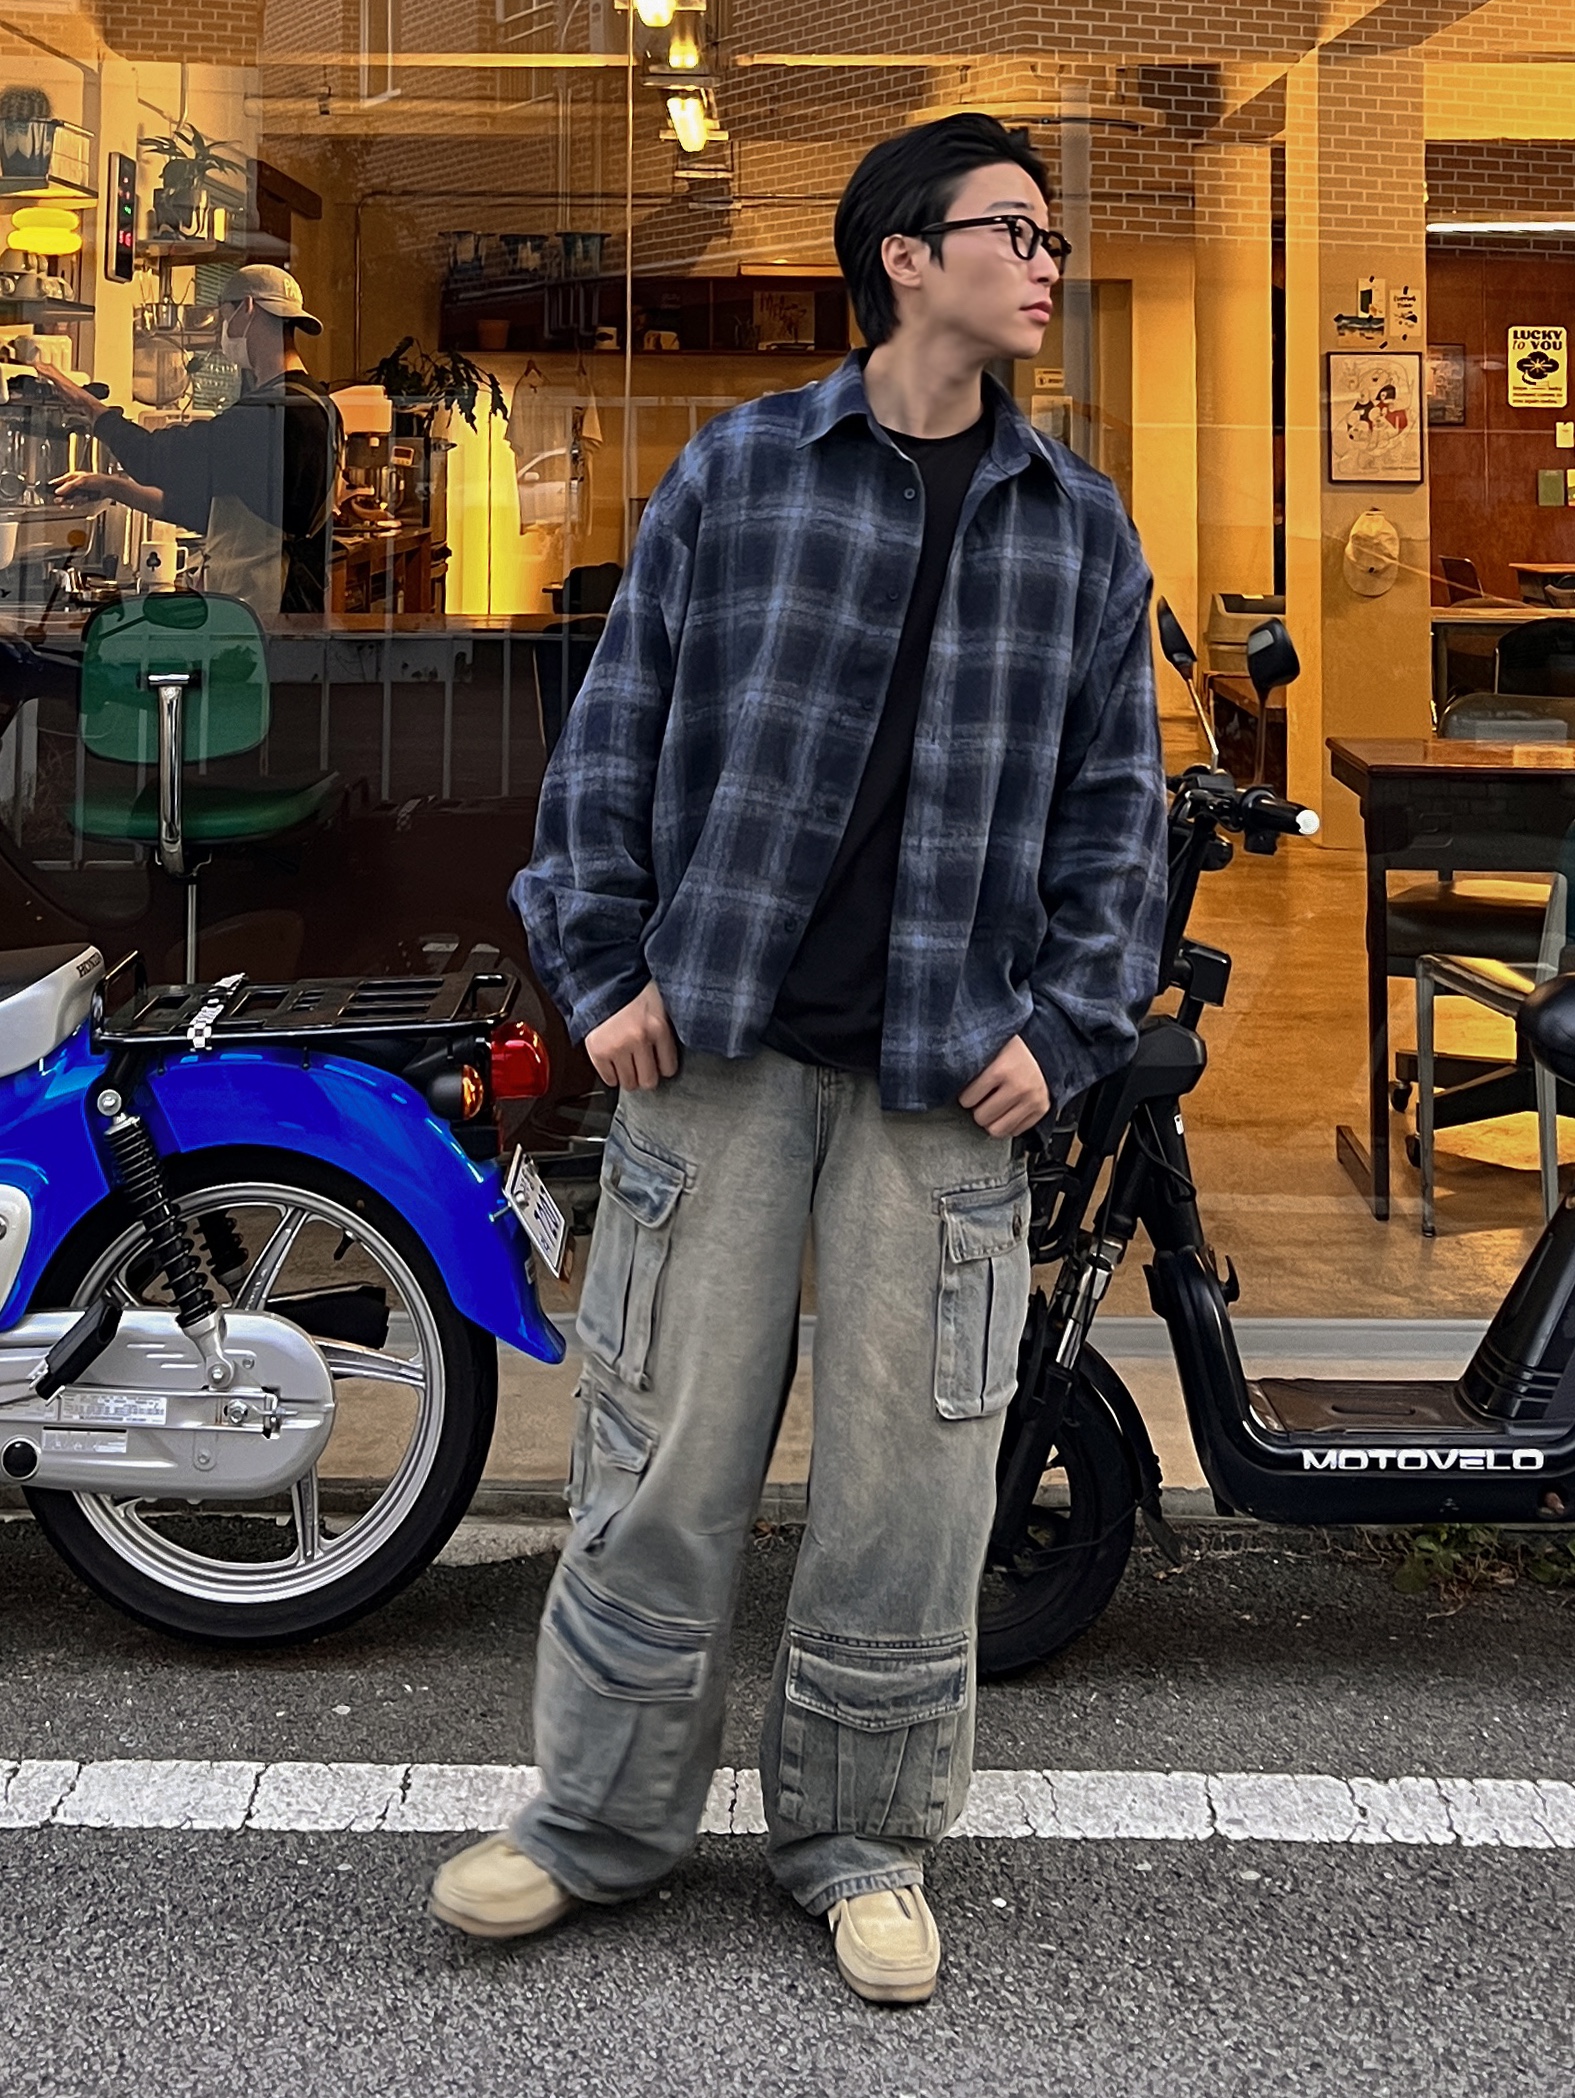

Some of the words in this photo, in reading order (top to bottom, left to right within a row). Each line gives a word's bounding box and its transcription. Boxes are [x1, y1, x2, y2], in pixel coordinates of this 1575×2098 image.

[1513, 330, 1563, 339] LUCKY
[1531, 341, 1562, 350] YOU
[1302, 1449, 1545, 1470] MOTOVELO
